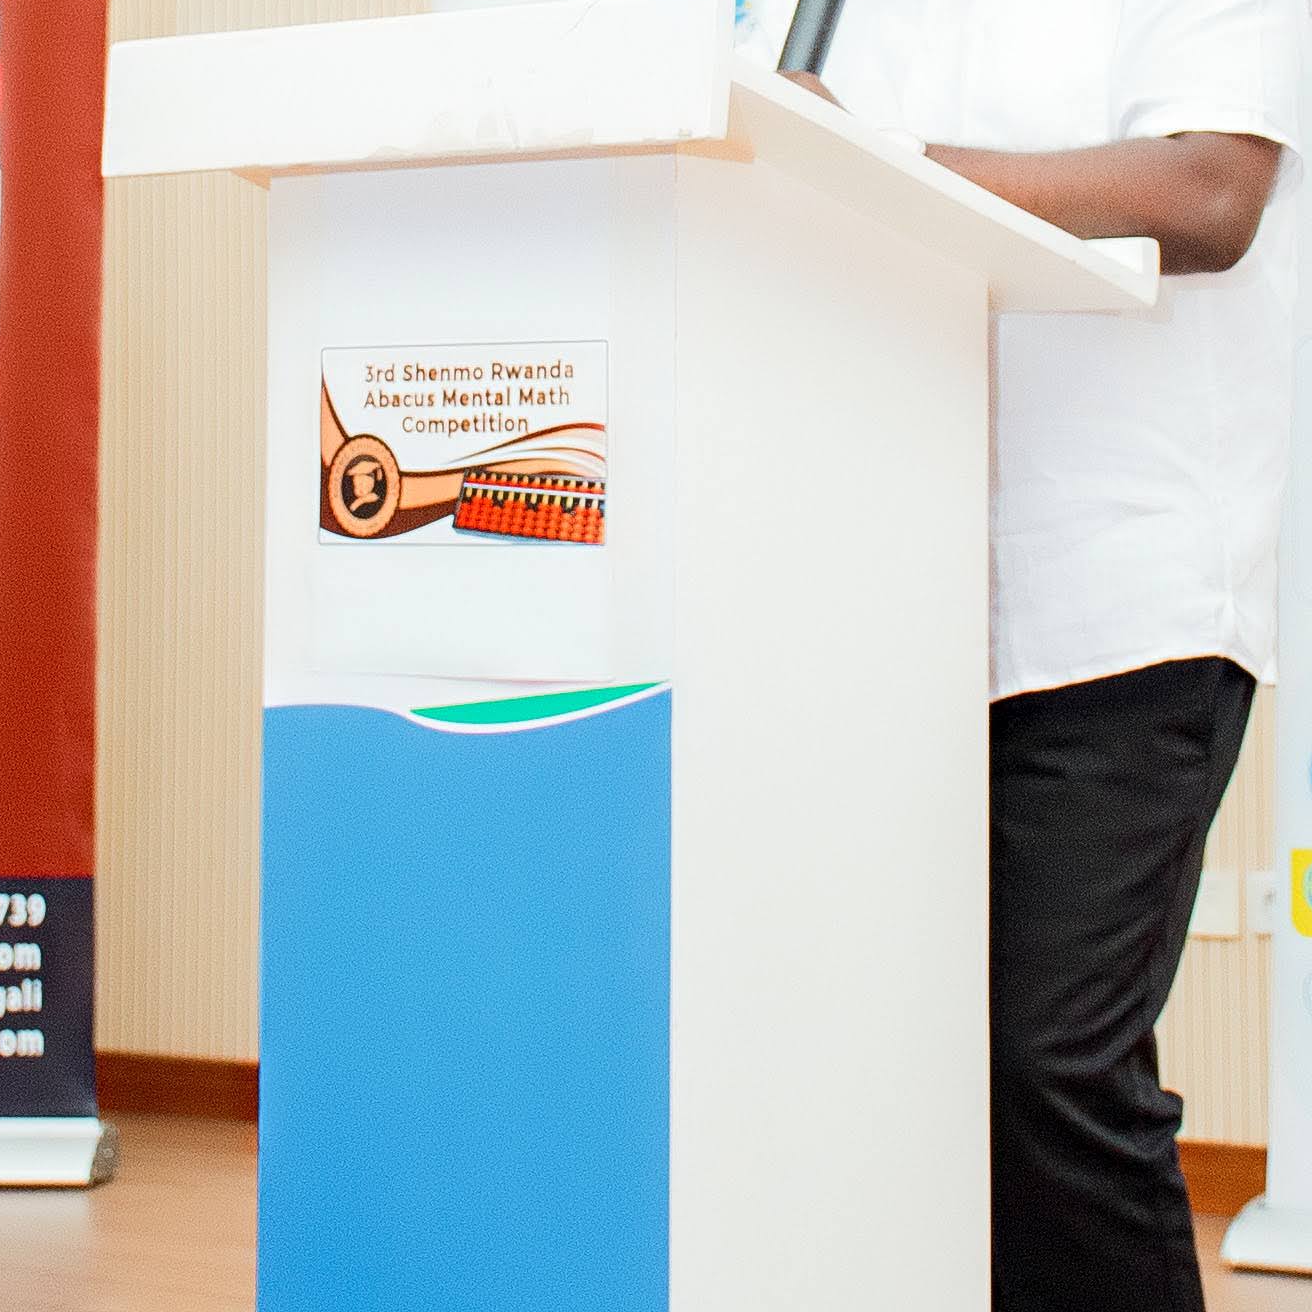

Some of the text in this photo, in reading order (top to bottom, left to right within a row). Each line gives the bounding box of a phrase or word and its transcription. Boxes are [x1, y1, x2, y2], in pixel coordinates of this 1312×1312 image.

[364, 360, 574, 384] 3rd Shenmo Rwanda
[364, 387, 569, 409] Abacus Mental Math
[402, 413, 529, 438] Competition
